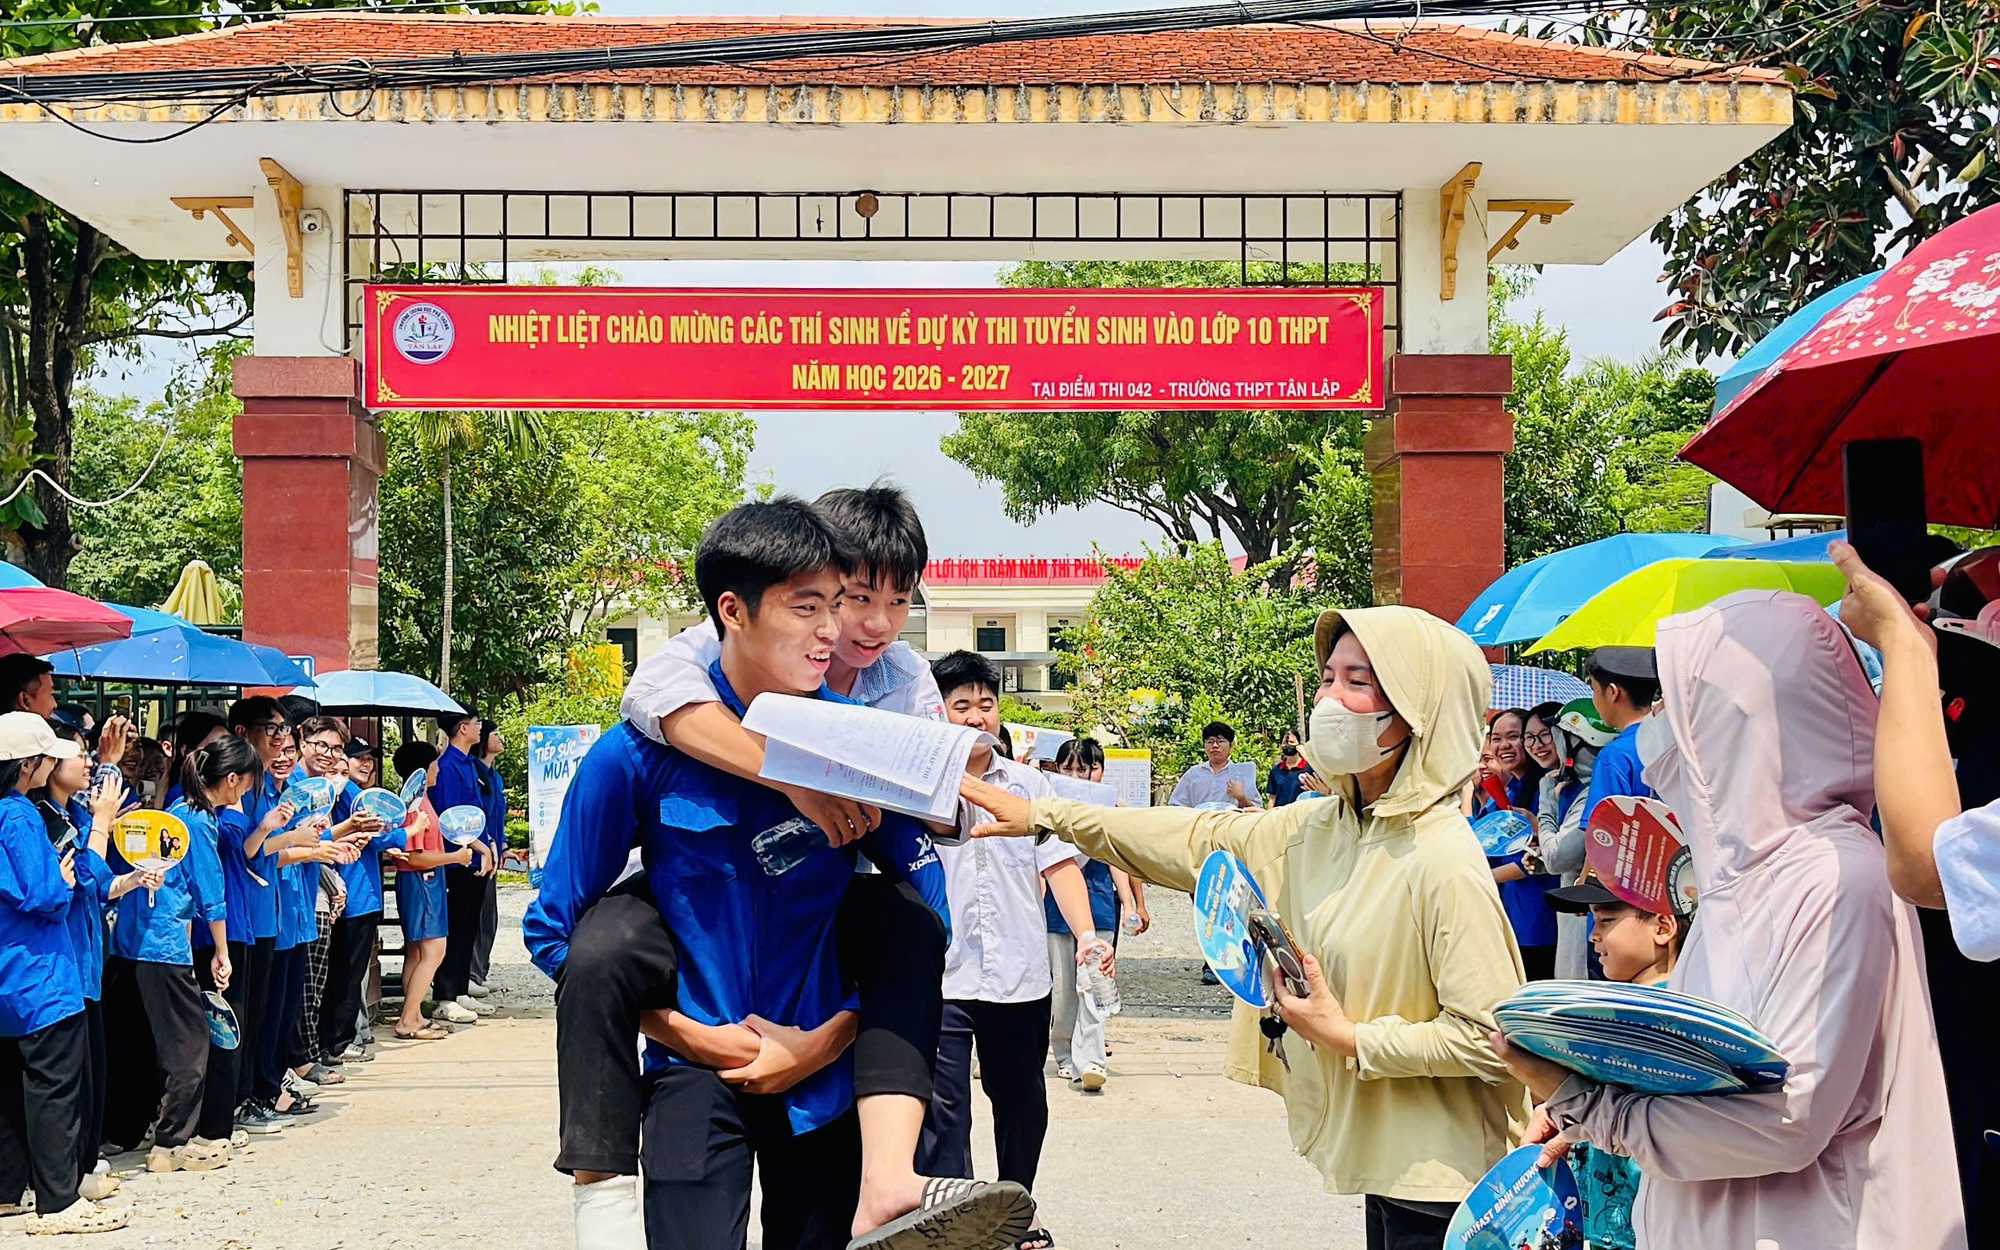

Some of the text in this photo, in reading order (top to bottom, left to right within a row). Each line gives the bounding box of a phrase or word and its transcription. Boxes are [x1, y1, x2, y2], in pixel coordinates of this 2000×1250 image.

[490, 305, 1329, 351] NHIỆT LIỆT CHÀO MỪNG CÁC THÍ SINH VỀ DỰ KỲ THI TUYỂN SINH VÀO LỚP 10 THPT
[792, 360, 839, 390] NĂM
[847, 364, 886, 396] HỌC
[893, 364, 941, 391] 2026
[962, 364, 1011, 391] 2027
[1032, 382, 1055, 400] TẠI
[1059, 374, 1095, 397] ĐIỂM
[1100, 382, 1123, 397] THI
[1127, 382, 1152, 397] 042
[1169, 378, 1231, 397] TRƯỜNG
[1235, 382, 1274, 397] THPT
[1278, 378, 1307, 397] TÂN
[1311, 378, 1341, 400] LẬP
[936, 557, 954, 583] LỢI
[958, 554, 978, 578] ÍCH
[983, 554, 1017, 579] TRĂM
[1020, 553, 1048, 579] NĂM
[1052, 553, 1070, 579] THÌ
[535, 738, 576, 762] TIẾP SỨC
[543, 759, 570, 782] MÙA
[1603, 1055, 1640, 1072] BÌNH
[1460, 1207, 1495, 1243] VINFAST
[1492, 1187, 1514, 1214] BÌNH
